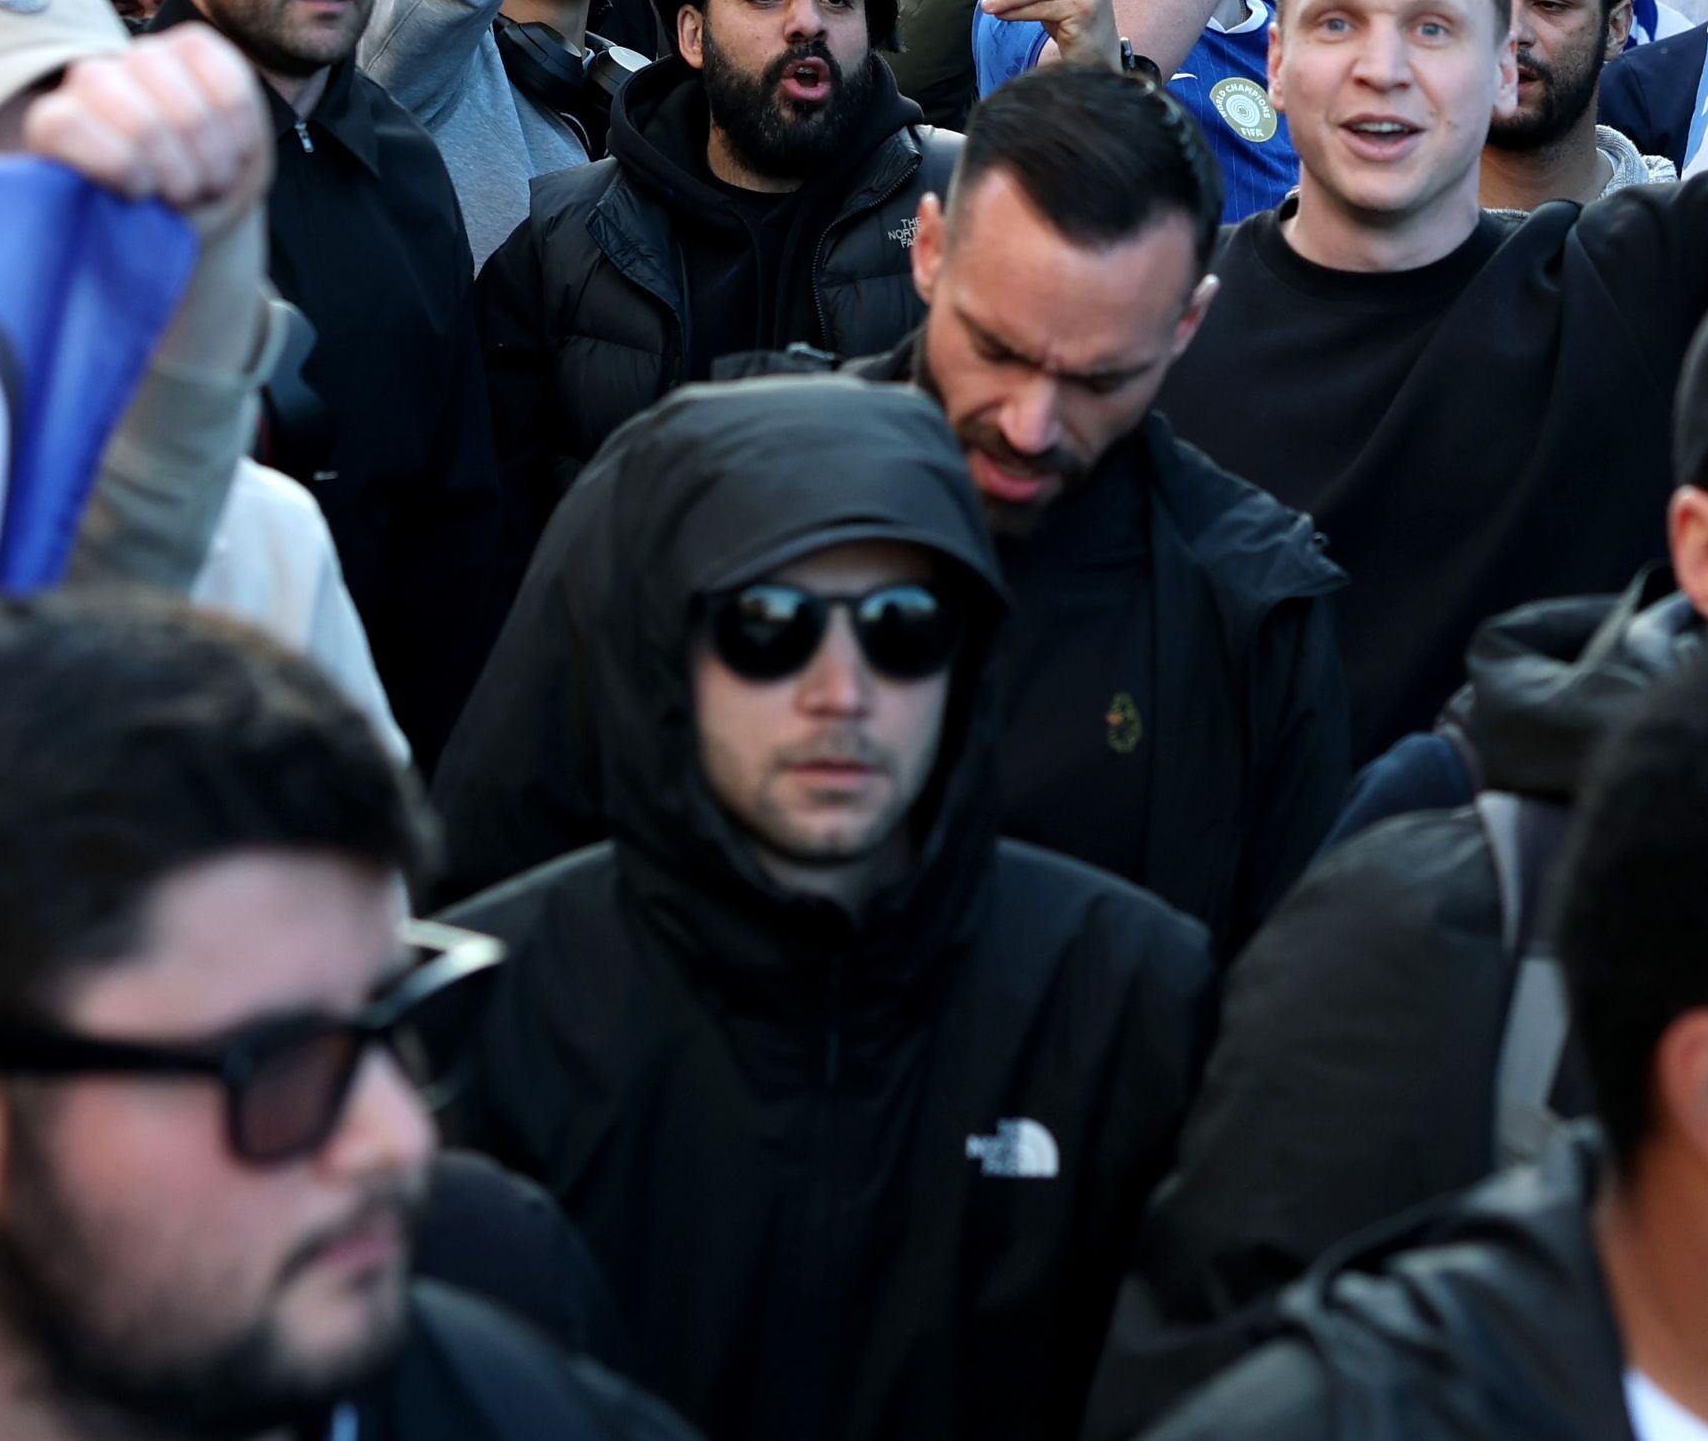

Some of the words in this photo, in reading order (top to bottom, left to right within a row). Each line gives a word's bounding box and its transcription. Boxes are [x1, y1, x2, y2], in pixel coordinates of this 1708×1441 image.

[1215, 89, 1228, 119] WORLD
[1225, 83, 1271, 119] CHAMPIONS
[1240, 127, 1265, 137] FIFA
[888, 226, 922, 241] NORT
